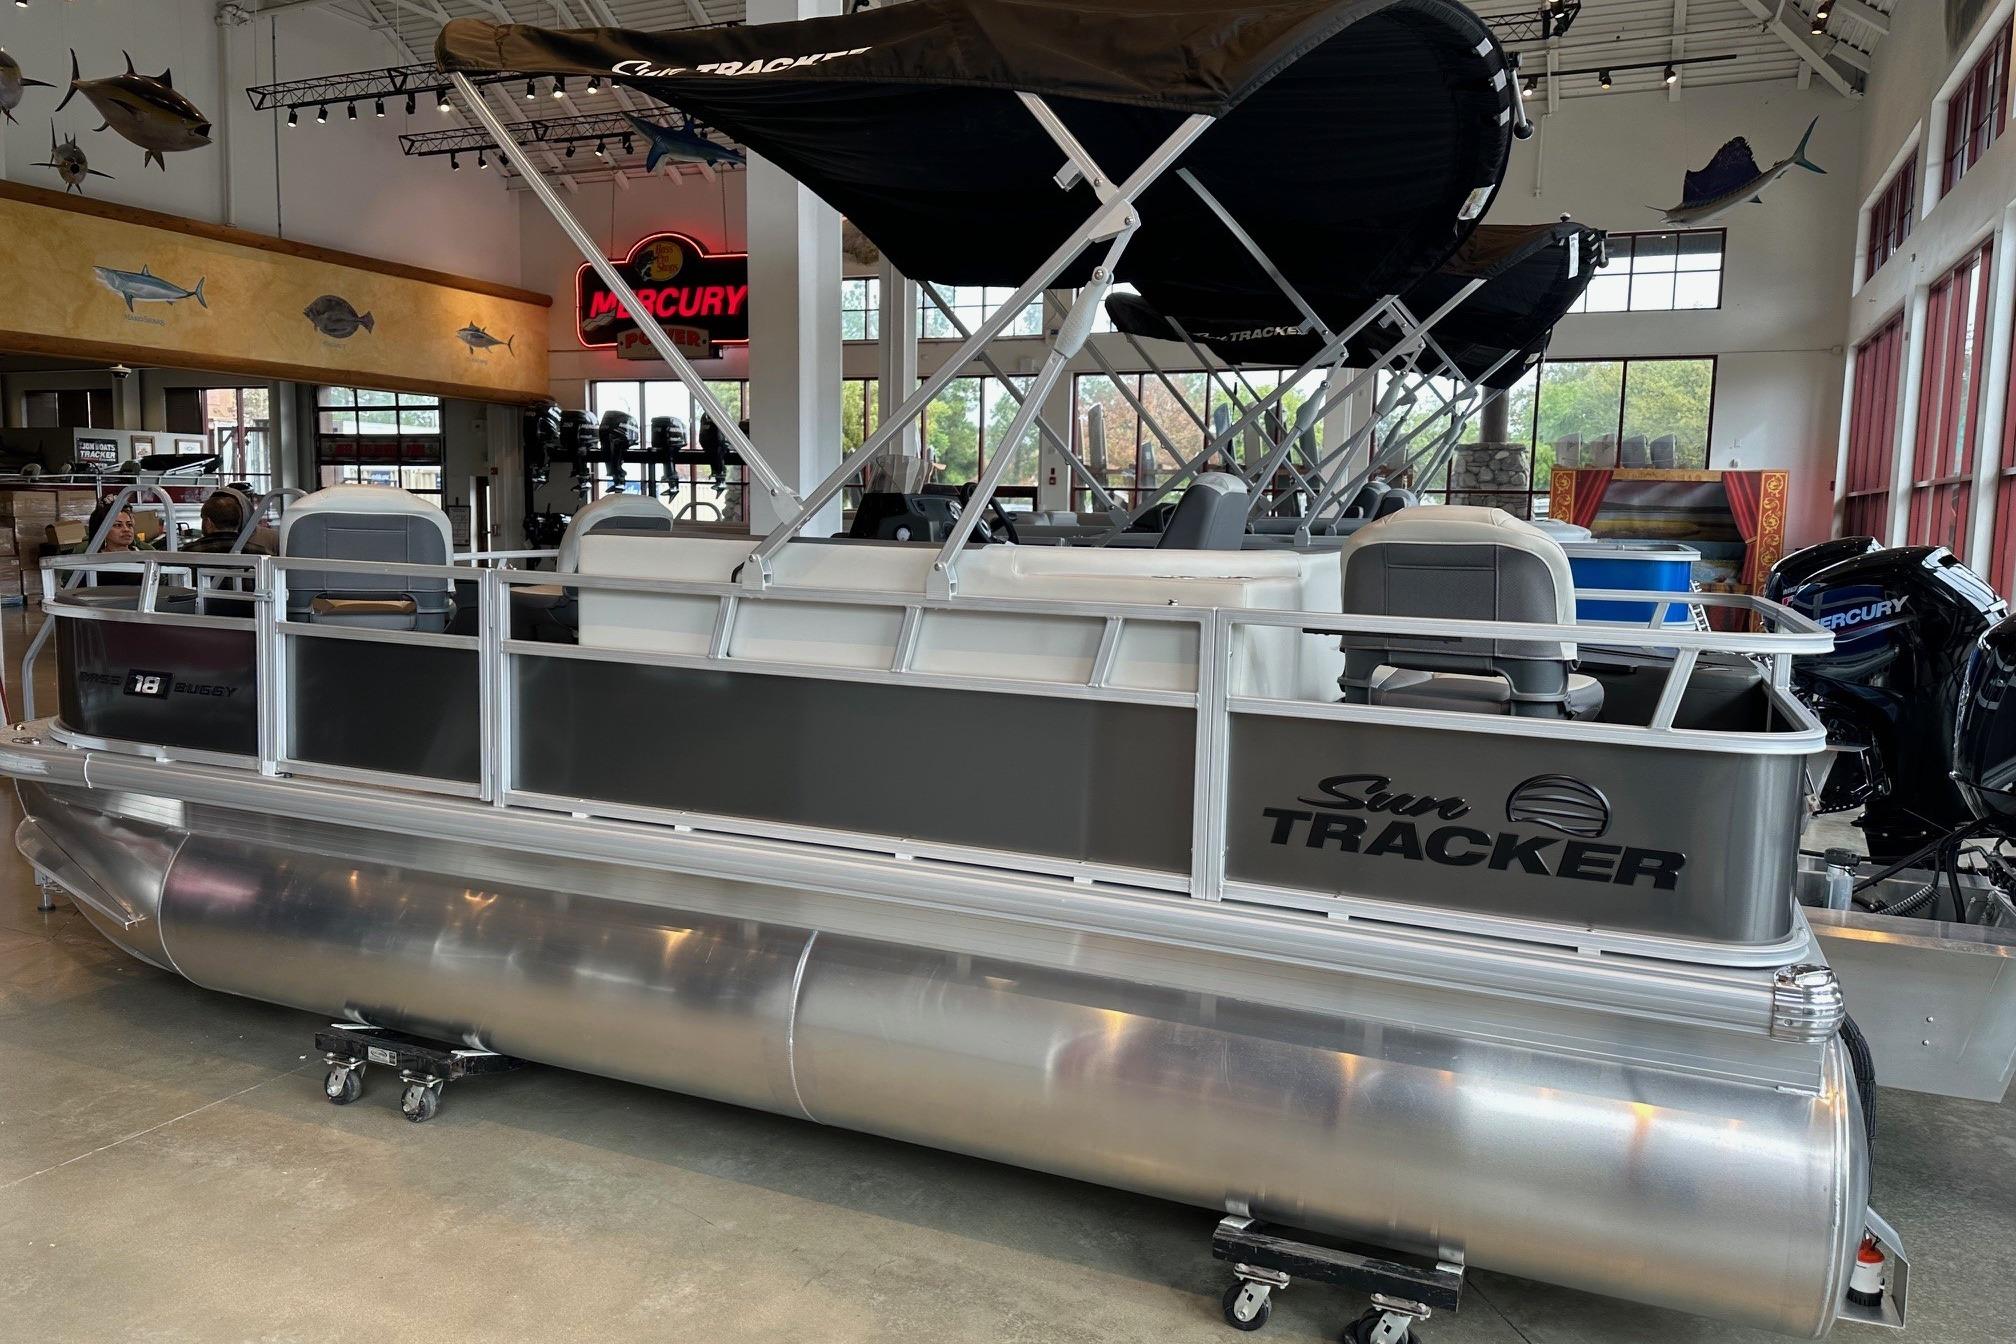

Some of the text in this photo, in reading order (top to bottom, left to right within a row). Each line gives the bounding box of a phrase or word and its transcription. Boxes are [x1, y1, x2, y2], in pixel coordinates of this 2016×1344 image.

[80, 450, 116, 459] TRACKER
[1814, 595, 1909, 631] ERCURY
[134, 674, 161, 694] 18
[173, 682, 239, 698] BUGGY
[1297, 773, 1472, 821] Sun
[1262, 807, 1687, 891] TRACKER
